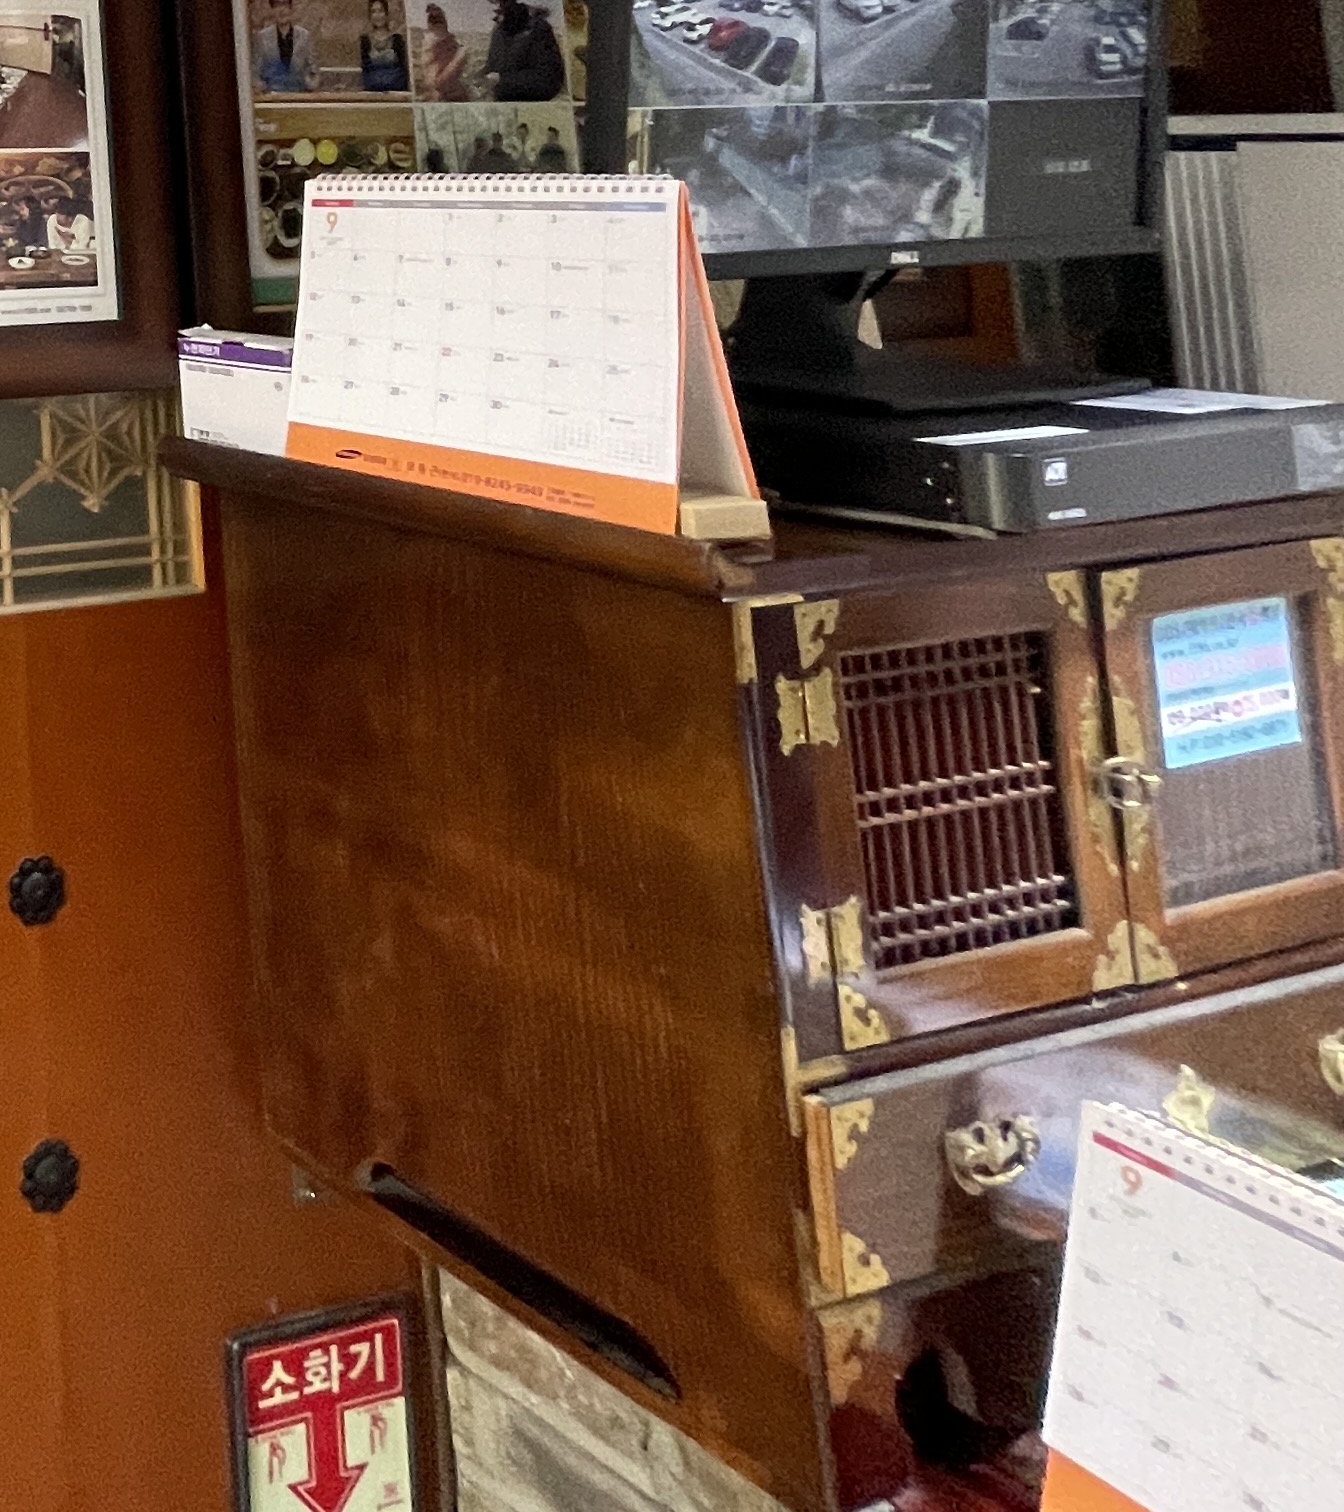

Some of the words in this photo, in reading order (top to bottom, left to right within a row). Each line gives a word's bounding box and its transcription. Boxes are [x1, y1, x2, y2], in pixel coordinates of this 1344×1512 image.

[326, 211, 339, 234] 9
[1120, 1165, 1143, 1196] 9
[257, 1332, 386, 1409] 소화기
